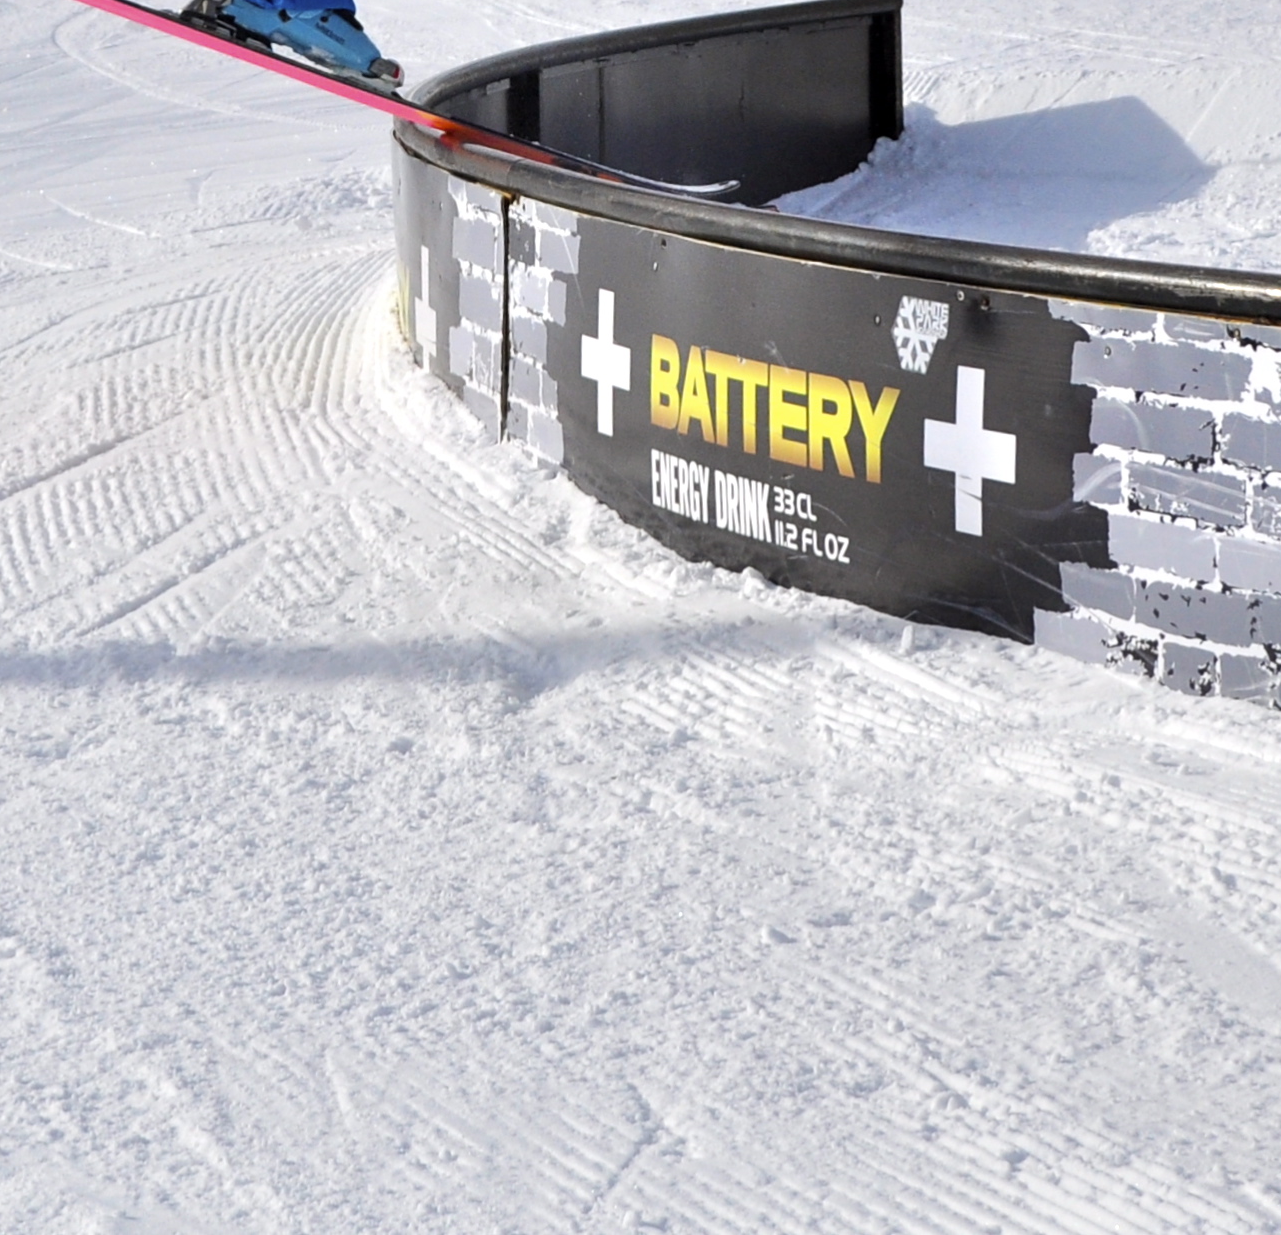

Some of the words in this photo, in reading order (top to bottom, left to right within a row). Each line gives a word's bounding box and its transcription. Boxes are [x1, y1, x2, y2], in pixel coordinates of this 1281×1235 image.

[912, 298, 950, 318] WHITE
[650, 333, 901, 484] BATTERY
[651, 448, 710, 524] ENERGY
[714, 469, 772, 544] DRINK
[774, 519, 799, 551] 11.2
[801, 527, 824, 557] FL
[824, 532, 851, 564] OZ
